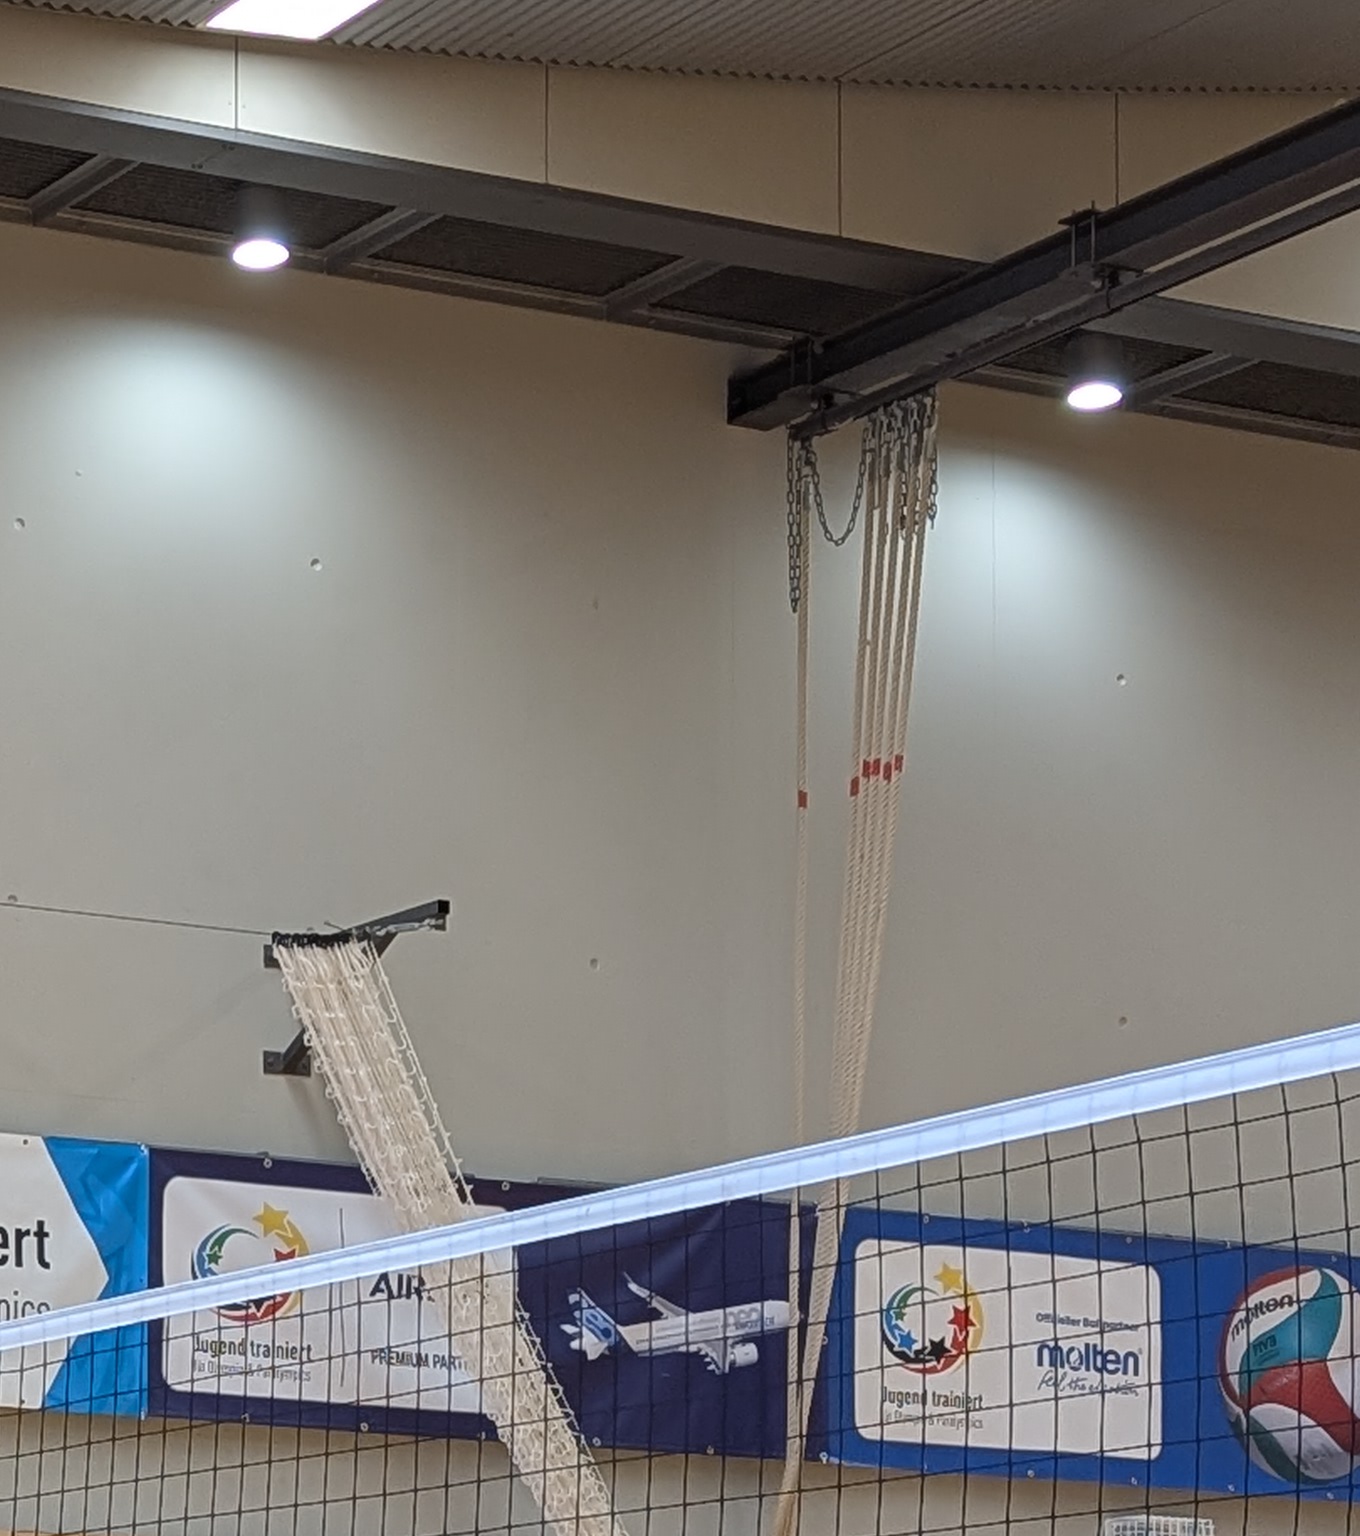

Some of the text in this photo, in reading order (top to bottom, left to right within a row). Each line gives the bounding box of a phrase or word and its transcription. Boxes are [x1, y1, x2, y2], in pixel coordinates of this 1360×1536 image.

[194, 1333, 312, 1362] Jugend traniert
[1036, 1342, 1140, 1377] molten
[881, 1385, 928, 1409] Jugend
